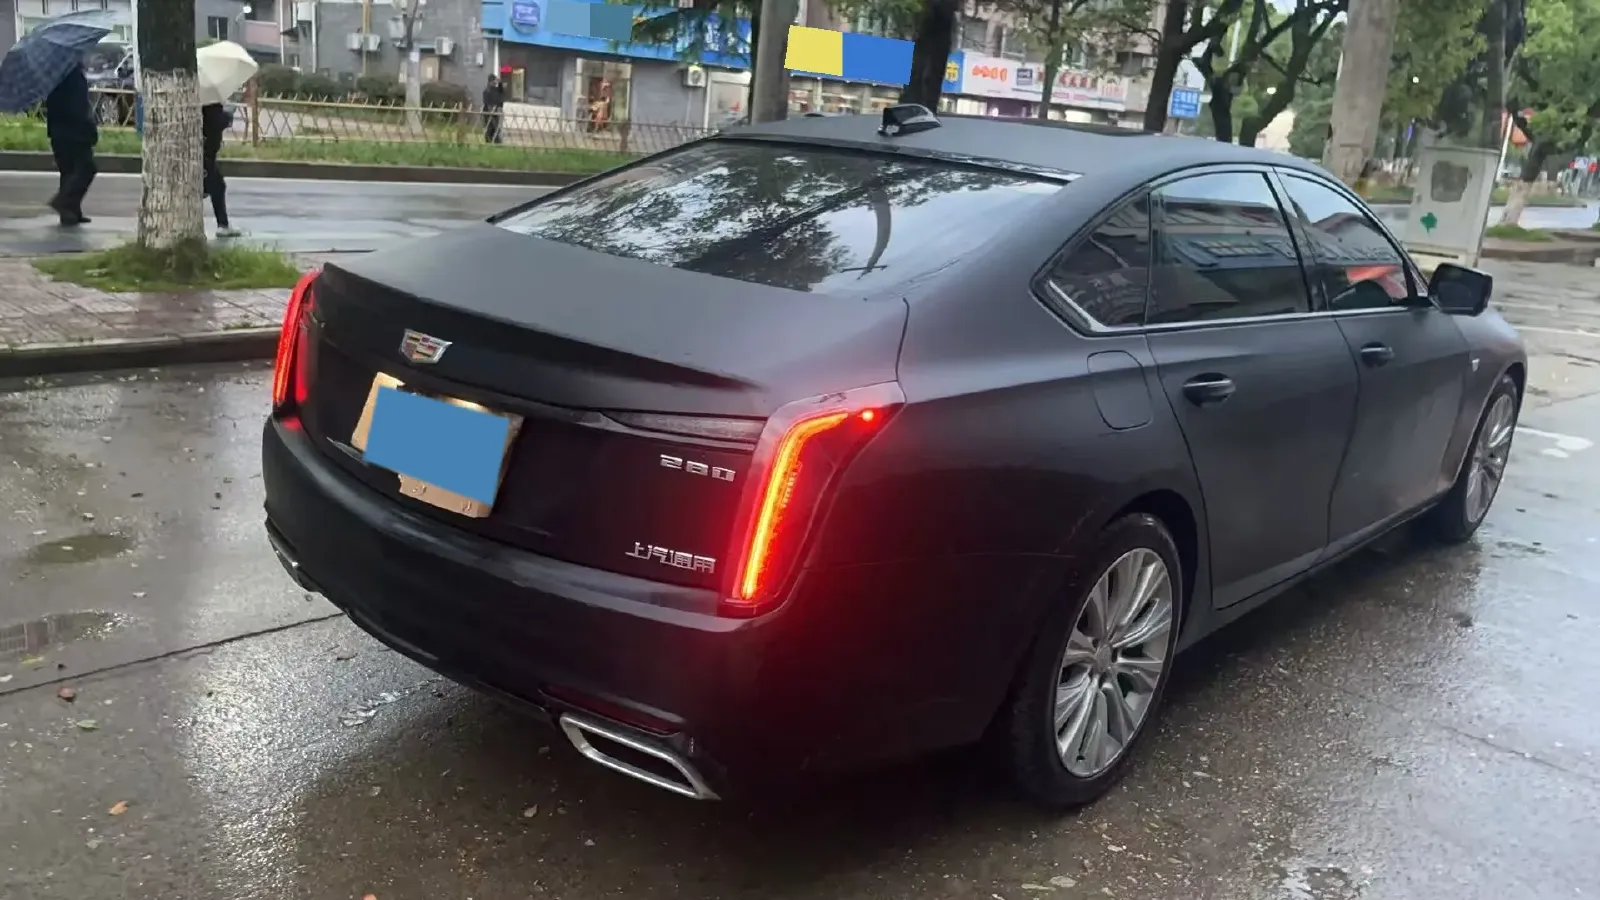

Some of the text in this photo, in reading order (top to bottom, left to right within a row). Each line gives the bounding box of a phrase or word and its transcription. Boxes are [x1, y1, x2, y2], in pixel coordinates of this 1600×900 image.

[660, 454, 736, 482] 280
[625, 542, 717, 573] 上汽通用
